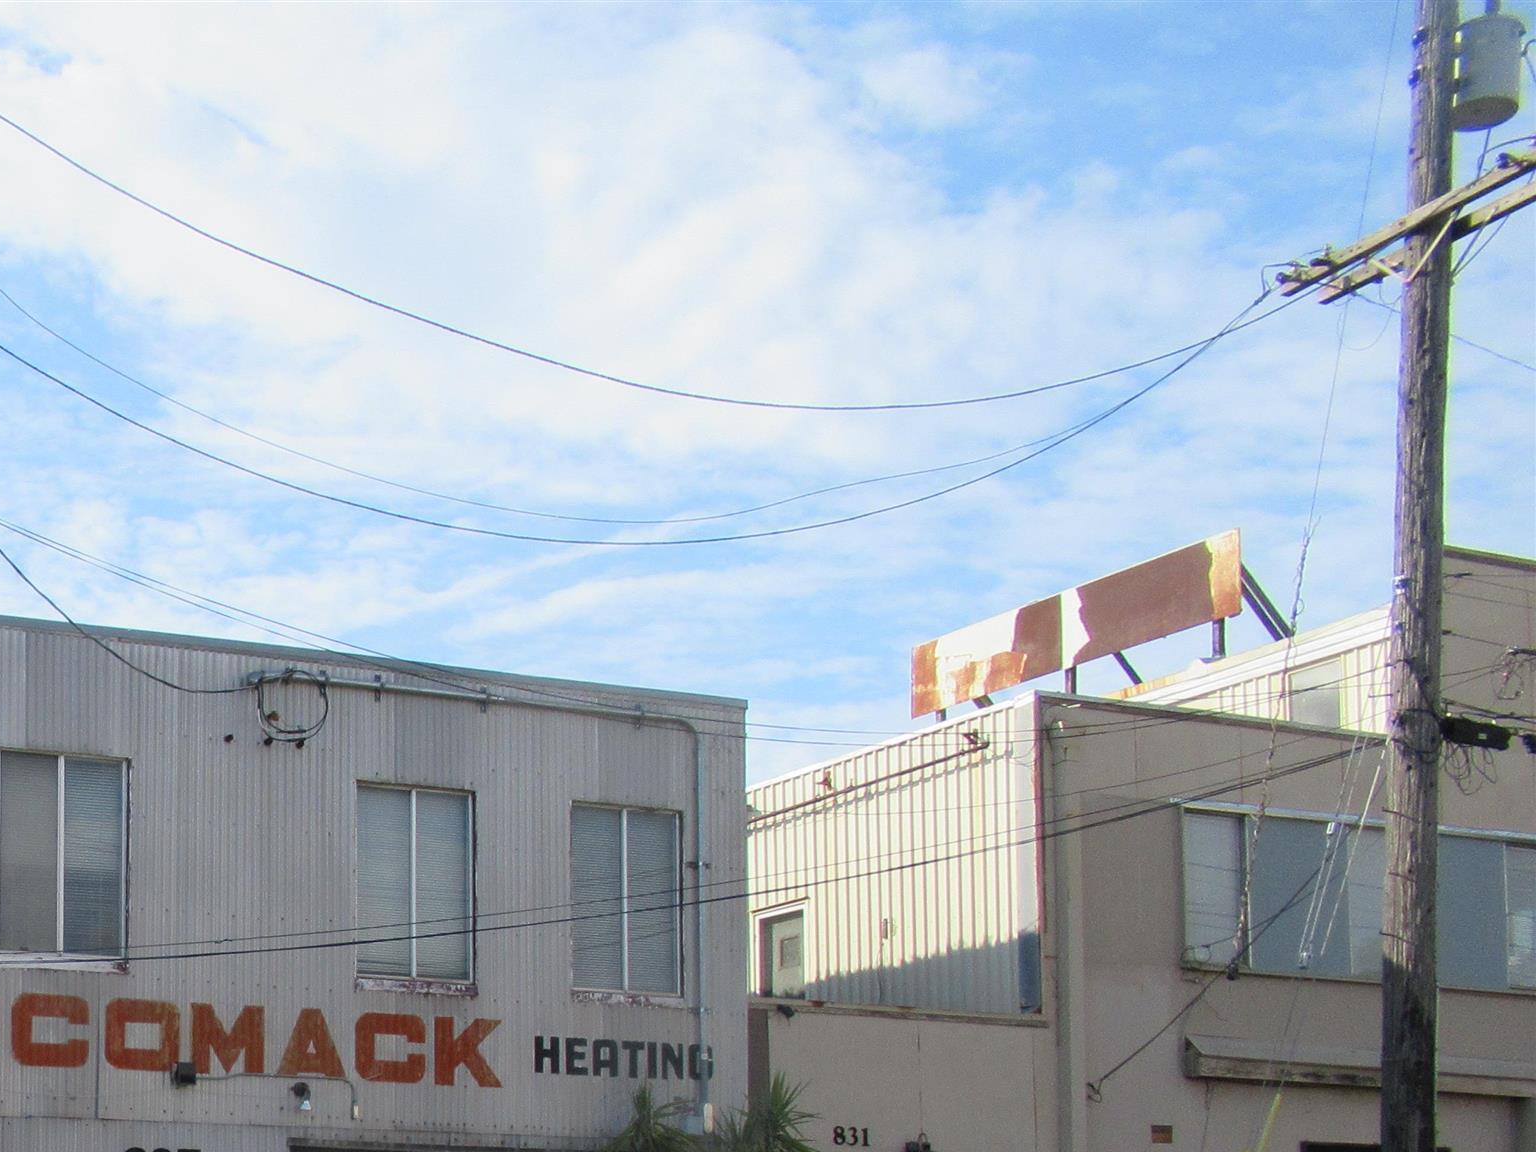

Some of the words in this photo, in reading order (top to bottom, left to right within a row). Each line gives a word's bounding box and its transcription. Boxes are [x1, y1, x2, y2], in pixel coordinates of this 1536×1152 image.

[11, 992, 503, 1088] COMACK
[534, 1035, 714, 1081] HEATING
[832, 1125, 871, 1147] 831
